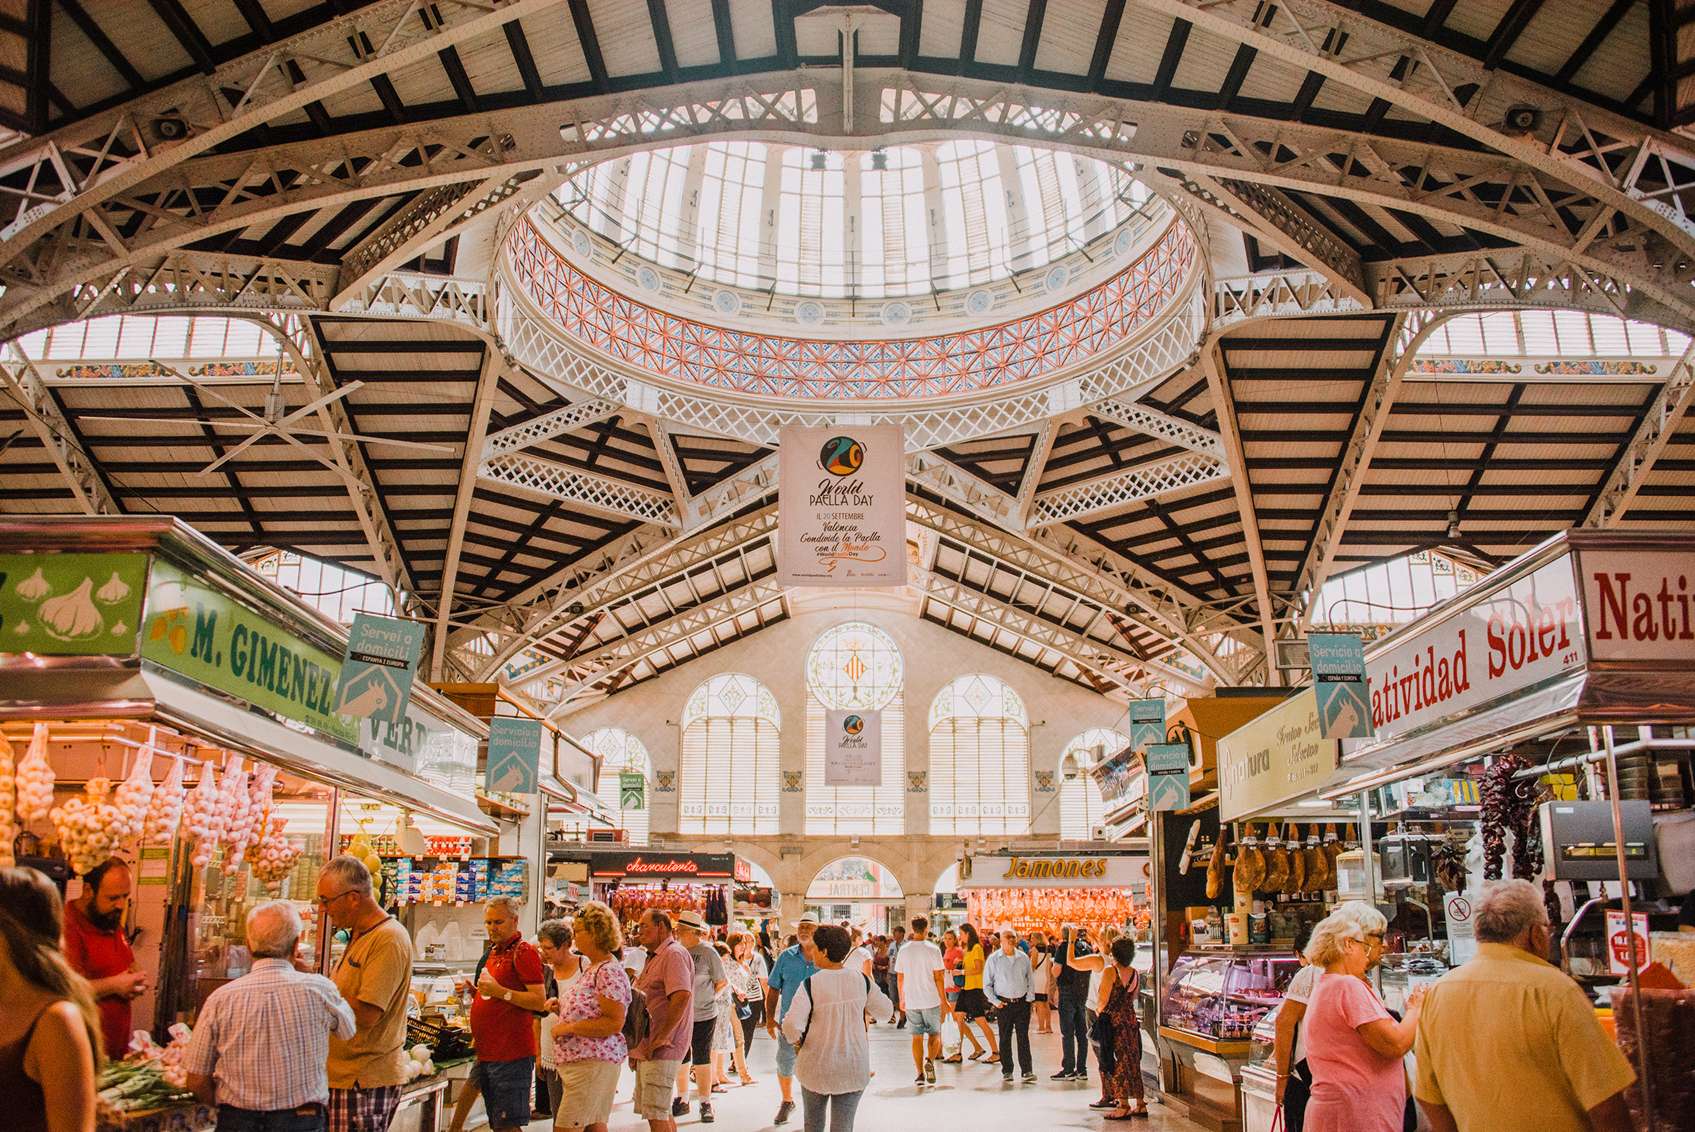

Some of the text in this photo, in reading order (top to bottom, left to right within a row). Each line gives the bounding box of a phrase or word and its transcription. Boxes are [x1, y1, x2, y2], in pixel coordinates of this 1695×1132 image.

[818, 477, 863, 497] World
[809, 495, 874, 506] PAELLA DAY
[822, 521, 858, 532] Valencia
[800, 531, 881, 544] Condivide la Paella
[1594, 573, 1695, 641] Nati
[361, 623, 402, 642] Servei
[191, 602, 332, 716] M. GIMENEZ
[356, 640, 411, 660] domicili
[1312, 644, 1352, 657] Servicio
[1563, 651, 1579, 665] 411
[1317, 659, 1361, 674] domicilio
[1367, 593, 1573, 730] atividad Soler
[1003, 855, 1108, 880] Jamones
